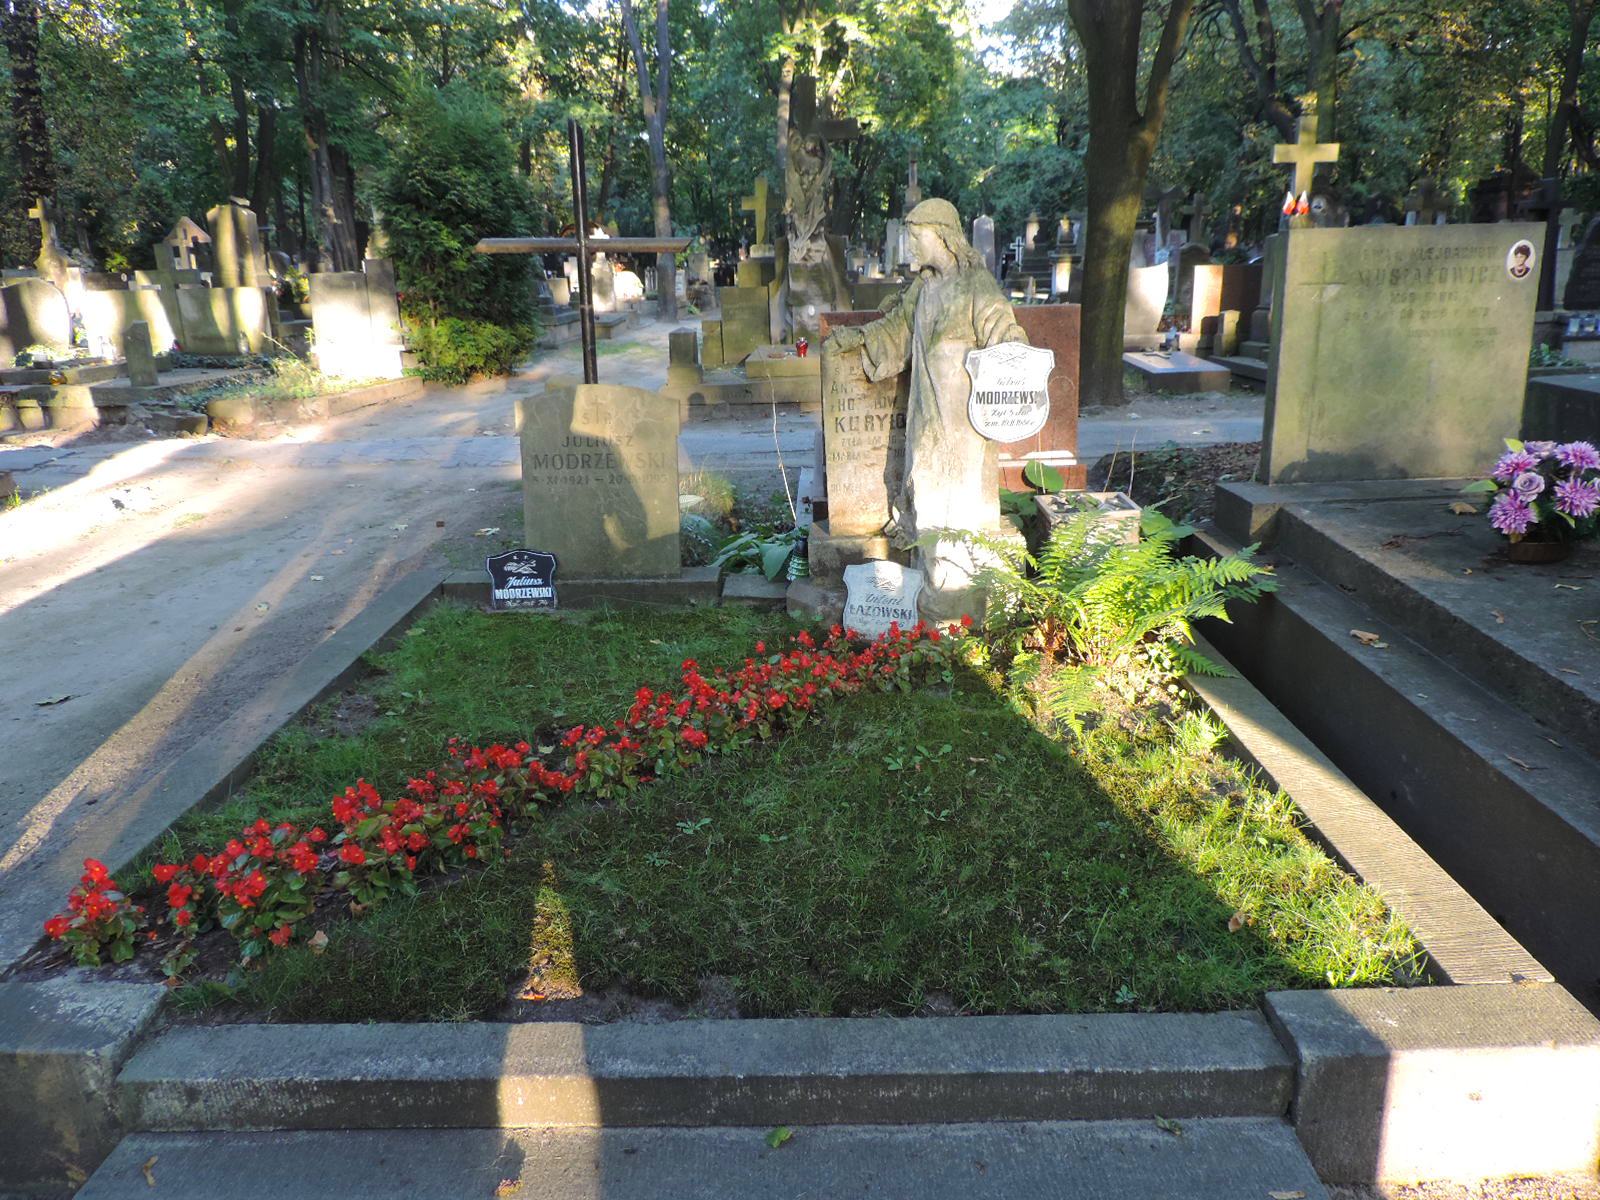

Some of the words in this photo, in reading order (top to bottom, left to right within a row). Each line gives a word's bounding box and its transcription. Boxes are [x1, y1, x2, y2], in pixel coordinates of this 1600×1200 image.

[975, 390, 1047, 405] MODRZEWS
[561, 435, 633, 448] JULIUSZ
[532, 453, 665, 471] MODRZEWSKI
[494, 587, 552, 600] MODRZEWSKI
